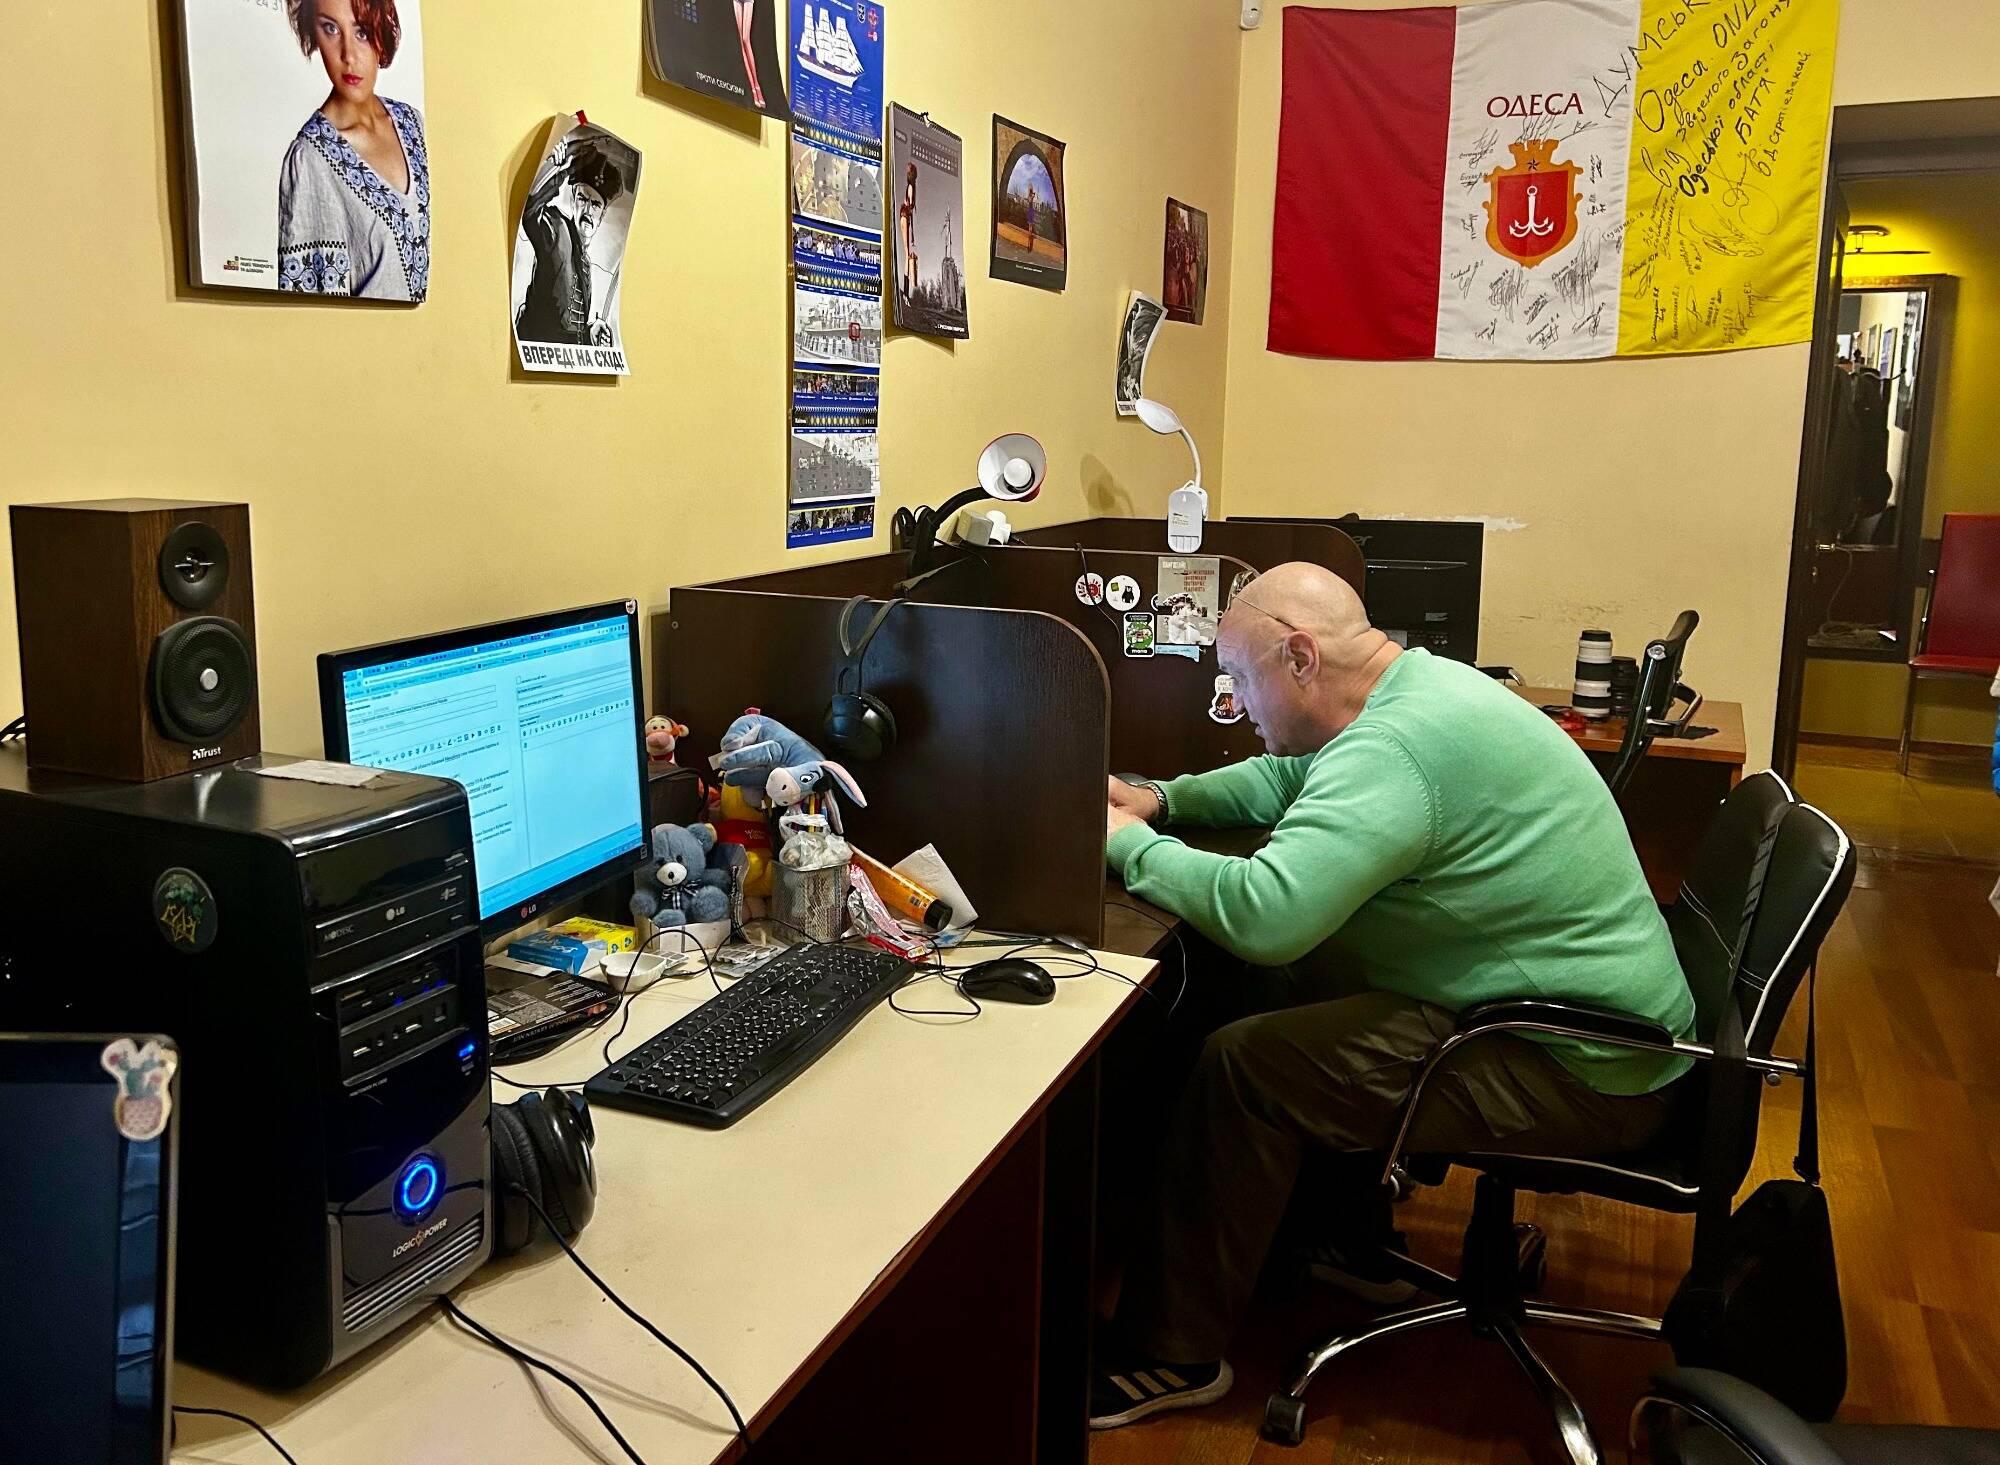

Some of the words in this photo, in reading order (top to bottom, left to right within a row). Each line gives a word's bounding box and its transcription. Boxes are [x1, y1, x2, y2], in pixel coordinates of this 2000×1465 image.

[1713, 0, 1757, 48] ONL
[1593, 0, 1710, 118] ДУМСЬК
[1486, 93, 1584, 118] ОДЕСА
[522, 346, 575, 369] ВПЕРЕД!
[575, 349, 594, 367] НА
[594, 350, 625, 372] СХІД!
[200, 746, 222, 759] Trust
[392, 1237, 415, 1258] LOGIC
[424, 1218, 448, 1238] POWER
